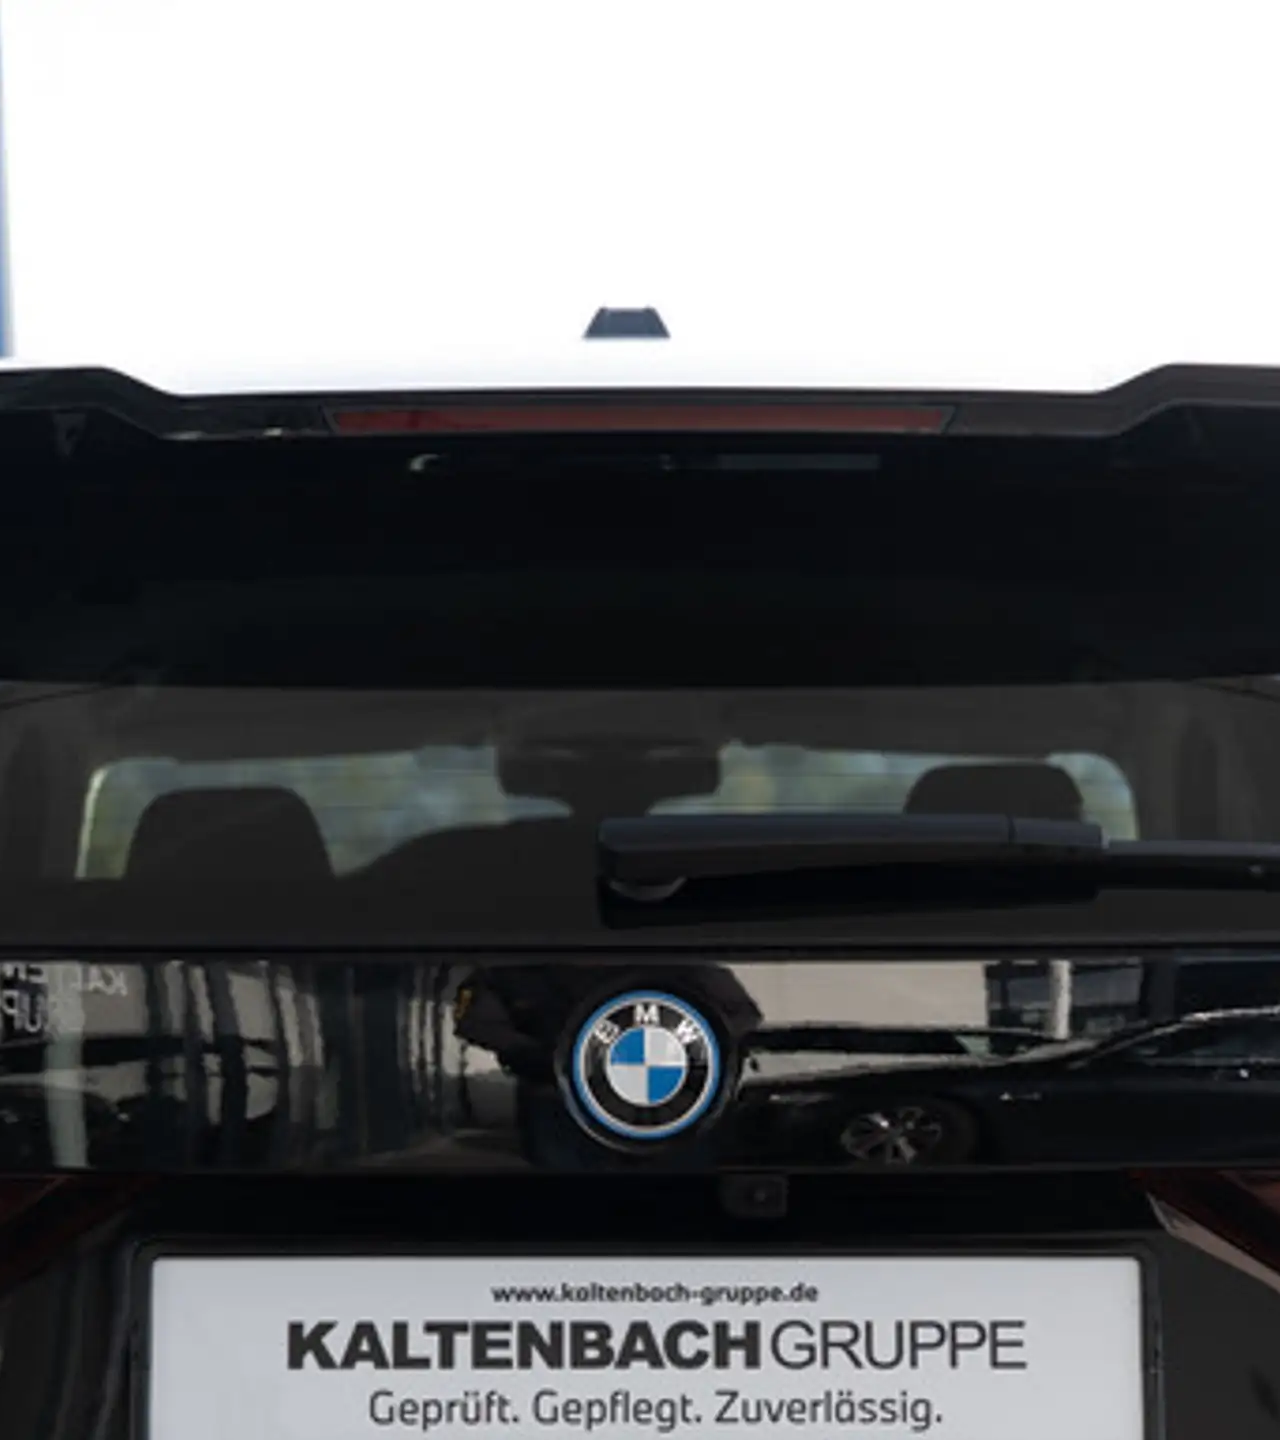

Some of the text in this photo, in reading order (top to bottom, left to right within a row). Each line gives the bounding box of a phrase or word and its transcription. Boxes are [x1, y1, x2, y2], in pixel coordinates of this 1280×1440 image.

[593, 1002, 701, 1045] BMW
[490, 1282, 820, 1305] www.kaltenbach-gruppe.de
[286, 1319, 1028, 1371] KALTENBACHGRUPPE
[369, 1388, 944, 1434] Geprüft. Gepflegt. Zuverlässig.
